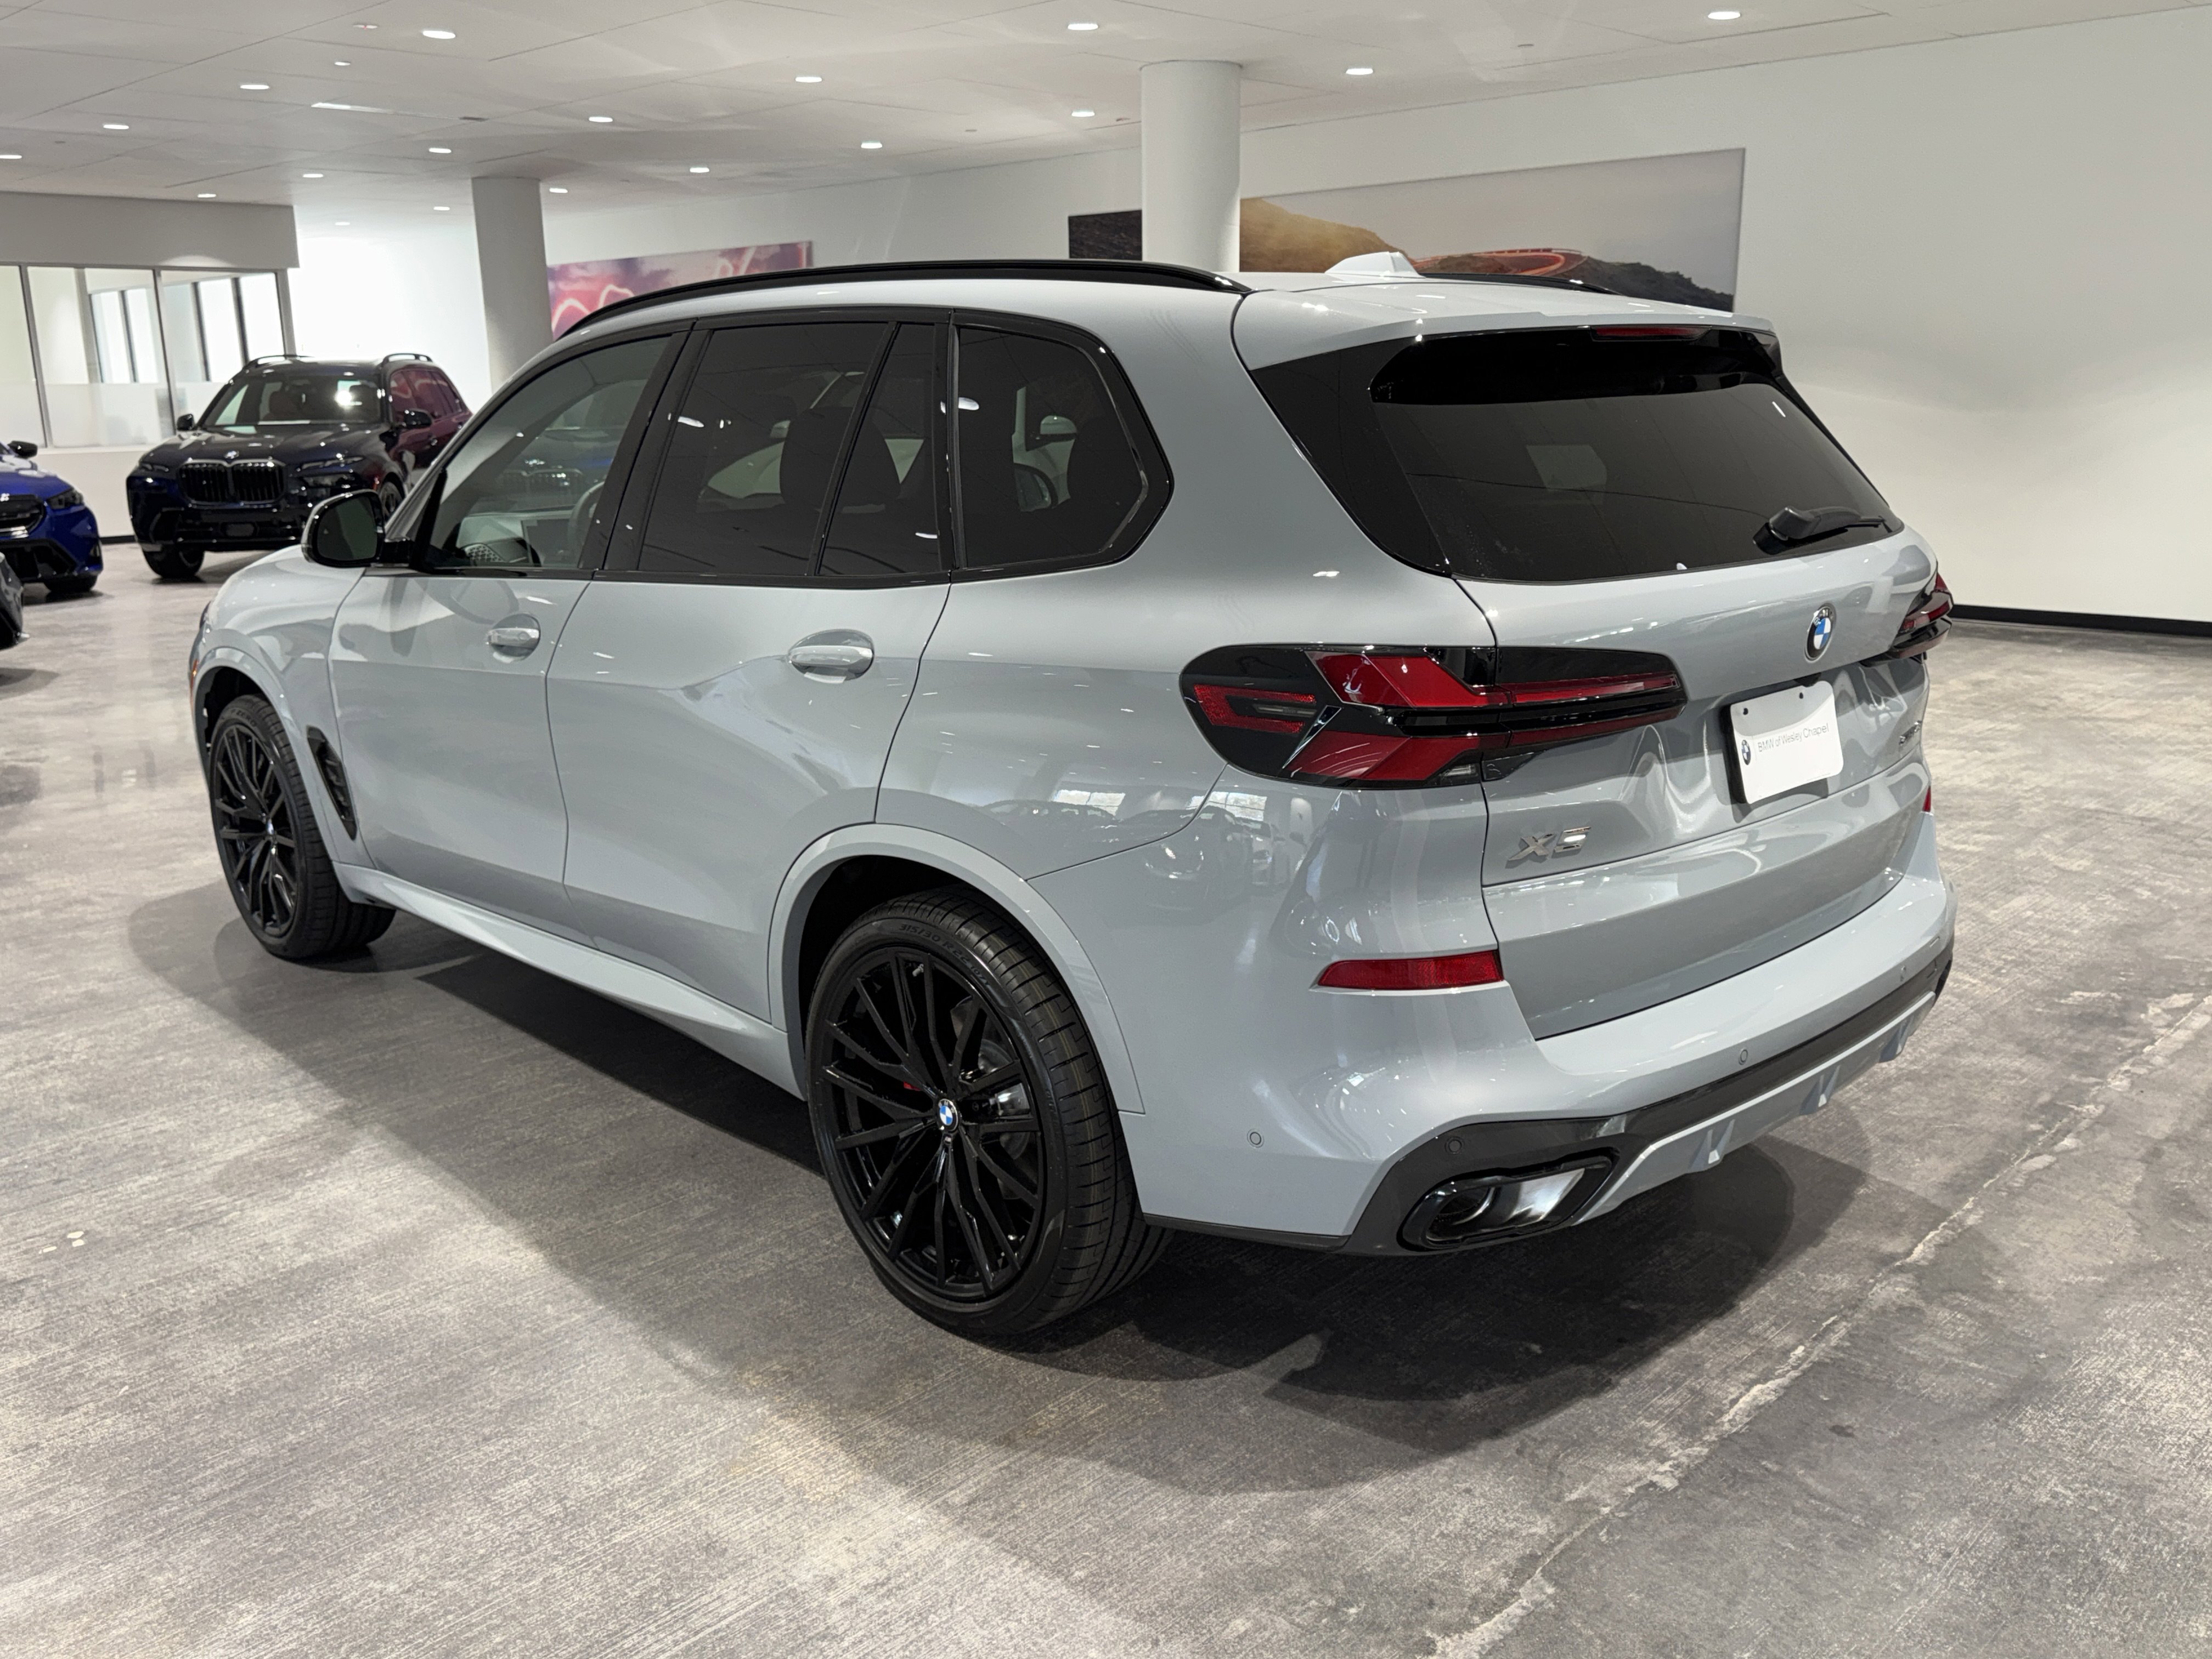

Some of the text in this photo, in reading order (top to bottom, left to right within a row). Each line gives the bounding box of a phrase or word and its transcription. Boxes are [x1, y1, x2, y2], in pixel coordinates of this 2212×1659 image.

[1758, 738, 1774, 752] BMW
[1775, 736, 1781, 747] of
[1782, 732, 1803, 744] Wesley
[1803, 723, 1830, 738] Chapel
[1507, 826, 1592, 863] X5
[899, 923, 941, 942] 315/30
